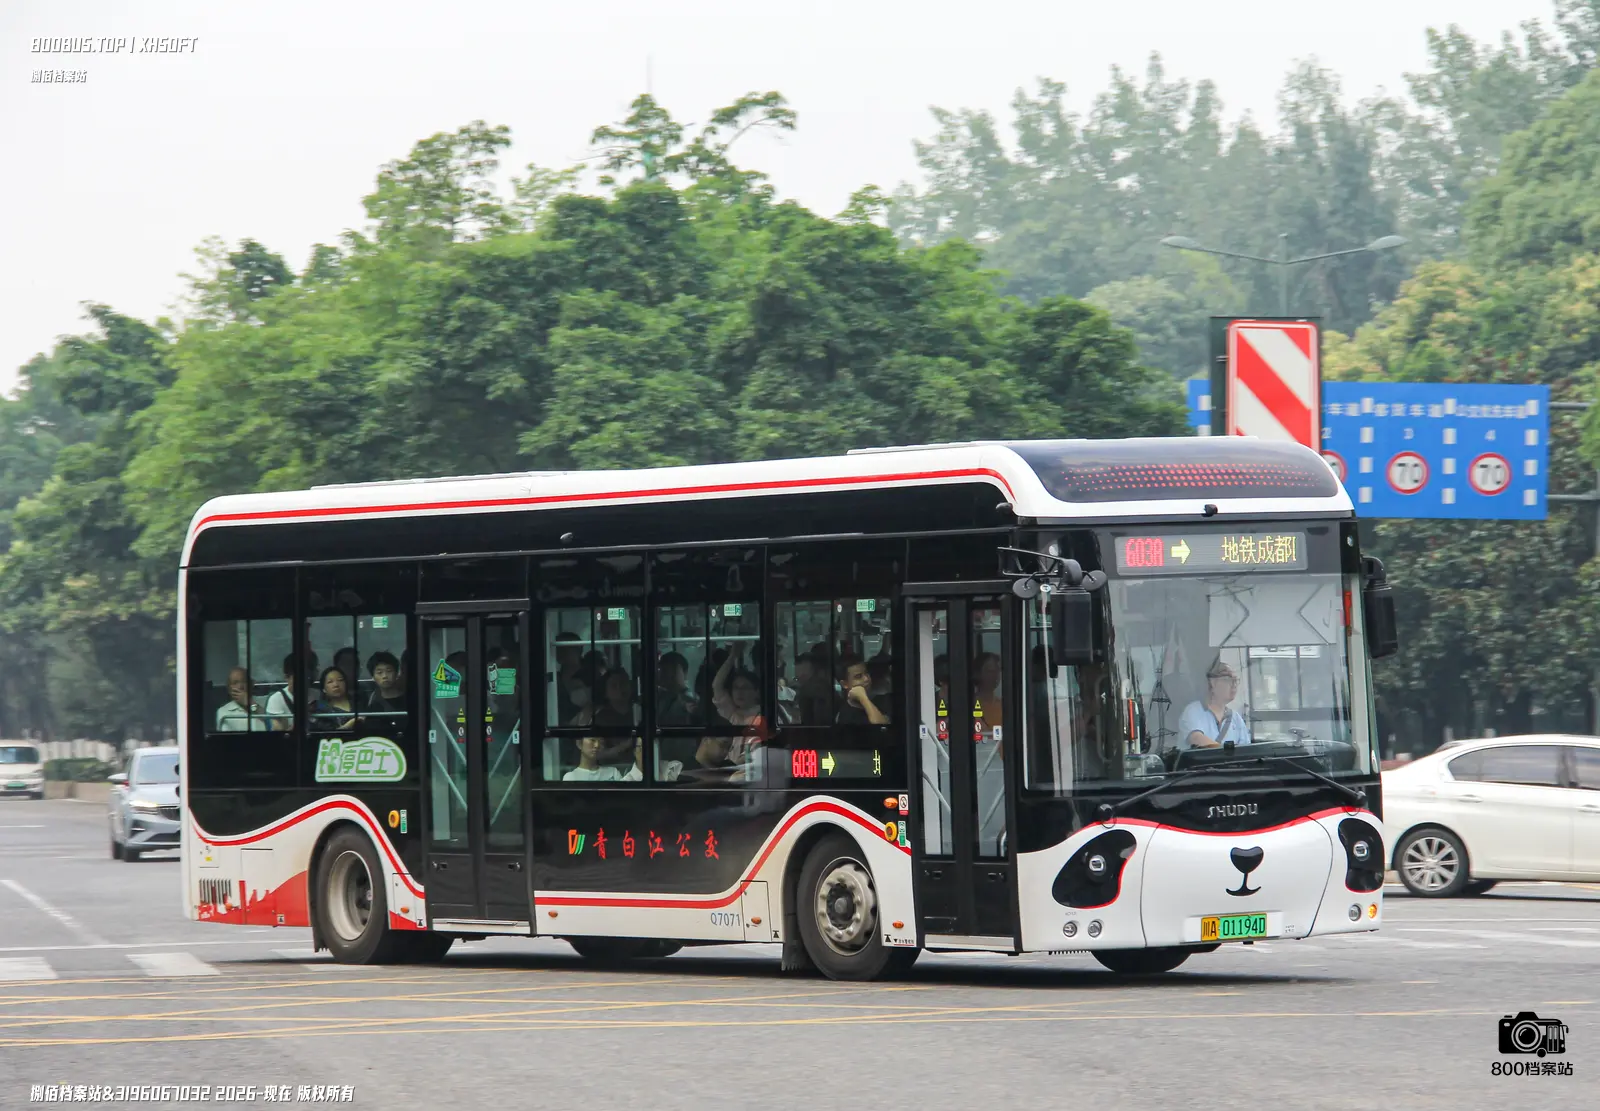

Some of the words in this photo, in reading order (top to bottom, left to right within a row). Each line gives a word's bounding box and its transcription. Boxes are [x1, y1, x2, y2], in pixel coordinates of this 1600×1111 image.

[1403, 428, 1415, 440] 3
[1484, 430, 1496, 441] 4
[1396, 462, 1424, 484] 70
[1478, 464, 1506, 486] 70
[1125, 538, 1164, 567] 603A
[792, 749, 817, 778] 603A
[1207, 803, 1259, 818] SHUDU
[593, 828, 719, 860] 青白江公交
[710, 912, 741, 927] Q7071
